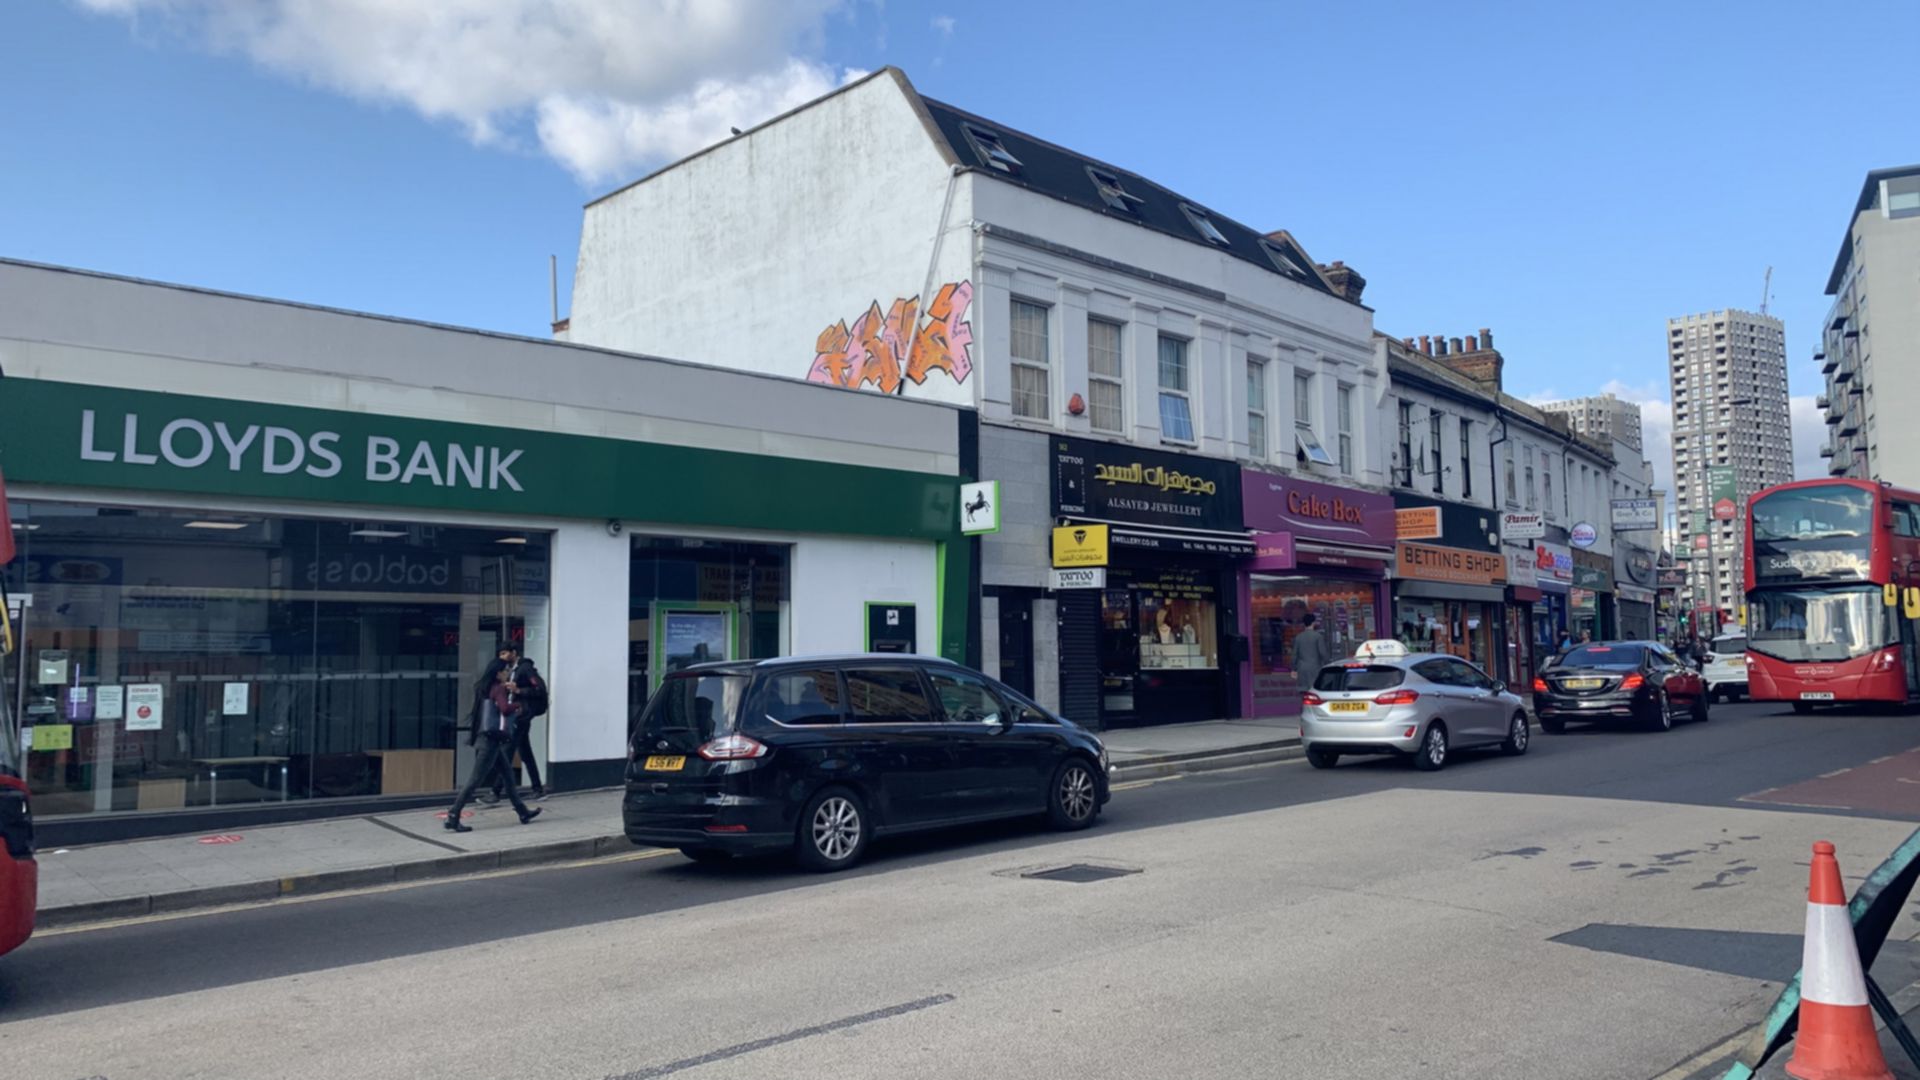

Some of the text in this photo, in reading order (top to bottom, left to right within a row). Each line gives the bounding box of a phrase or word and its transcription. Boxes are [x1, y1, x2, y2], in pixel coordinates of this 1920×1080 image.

[80, 409, 525, 492] LLOYDS BANK
[1058, 455, 1084, 465] TATTOO
[1093, 463, 1143, 486] السيد
[1144, 466, 1217, 495] مجوهرات
[1069, 479, 1076, 489] &
[1060, 504, 1085, 513] PIERCING
[1107, 498, 1203, 516] ALSAYED JEWELLERY
[1287, 490, 1364, 525] Cake Box
[1405, 547, 1462, 570] BETTING
[1466, 555, 1500, 573] SHOP
[1770, 558, 1817, 570] Sudbury
[1059, 570, 1094, 581] TATTOO
[1331, 702, 1367, 712] GK69 ZGA
